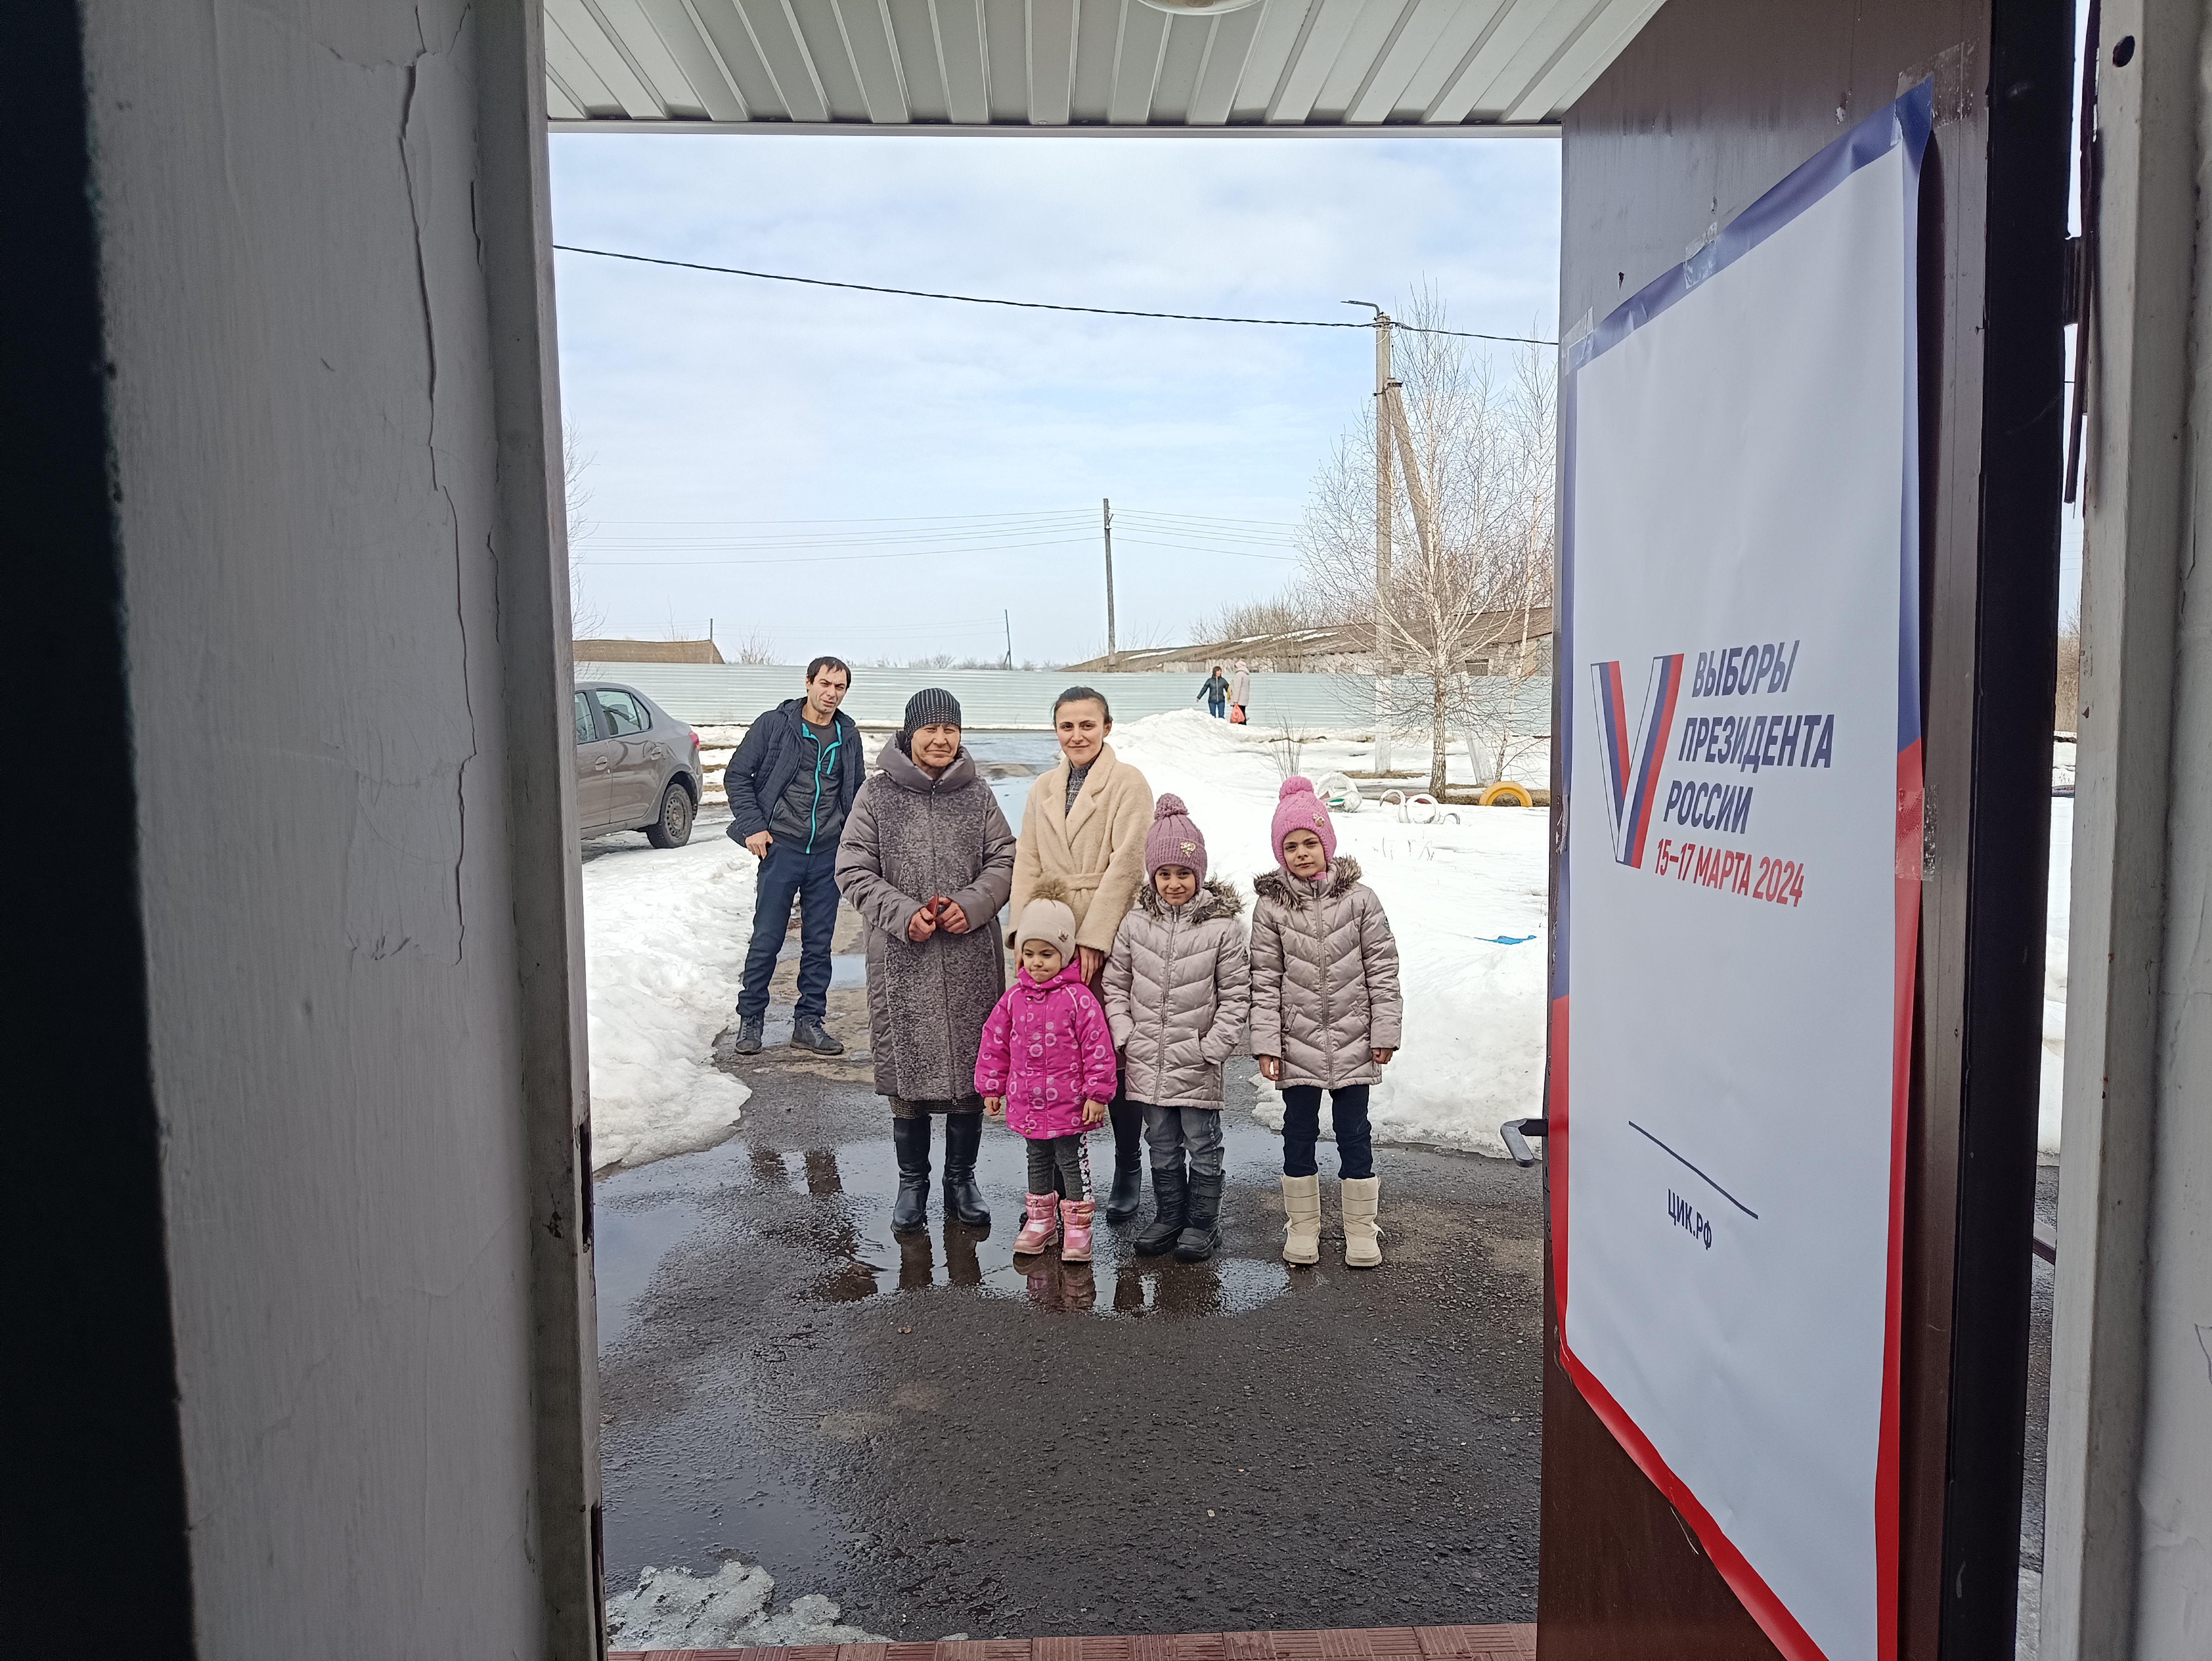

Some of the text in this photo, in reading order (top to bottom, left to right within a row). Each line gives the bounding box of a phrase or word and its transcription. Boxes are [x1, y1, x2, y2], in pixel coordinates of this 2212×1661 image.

[1692, 640, 1800, 698] ВЫБОРЫ
[1678, 714, 1835, 773] ПРЕЗИДЕНТА
[1663, 780, 1754, 834] РОССИИ
[1693, 845, 1752, 896] МАРТА
[1752, 856, 1804, 908] 2024
[1668, 1188, 1712, 1251] ЦИК.РФ
